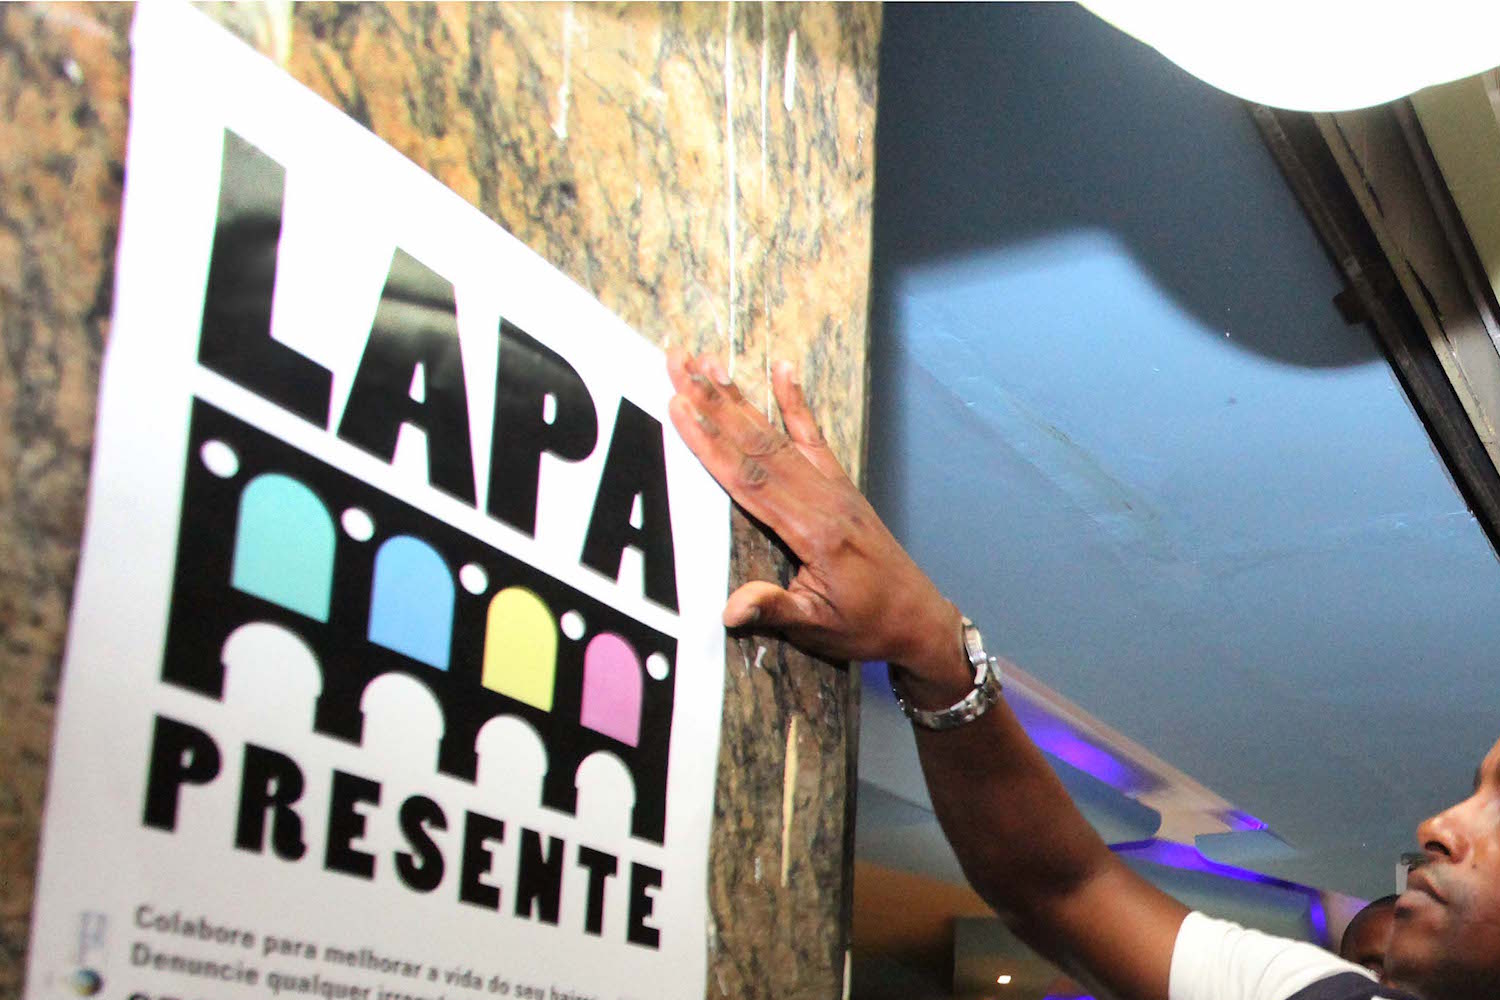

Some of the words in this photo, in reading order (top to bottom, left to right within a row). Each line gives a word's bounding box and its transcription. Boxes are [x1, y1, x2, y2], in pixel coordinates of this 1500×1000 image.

[197, 126, 681, 614] LAPA
[141, 714, 663, 950] PRESENTE
[130, 942, 259, 985] Denuncie
[134, 904, 255, 949] Colabore
[263, 935, 317, 959] para
[324, 946, 421, 979] melhorar
[427, 966, 439, 982] a
[444, 965, 483, 990] vida
[488, 975, 510, 995] do
[514, 983, 545, 1000] seu
